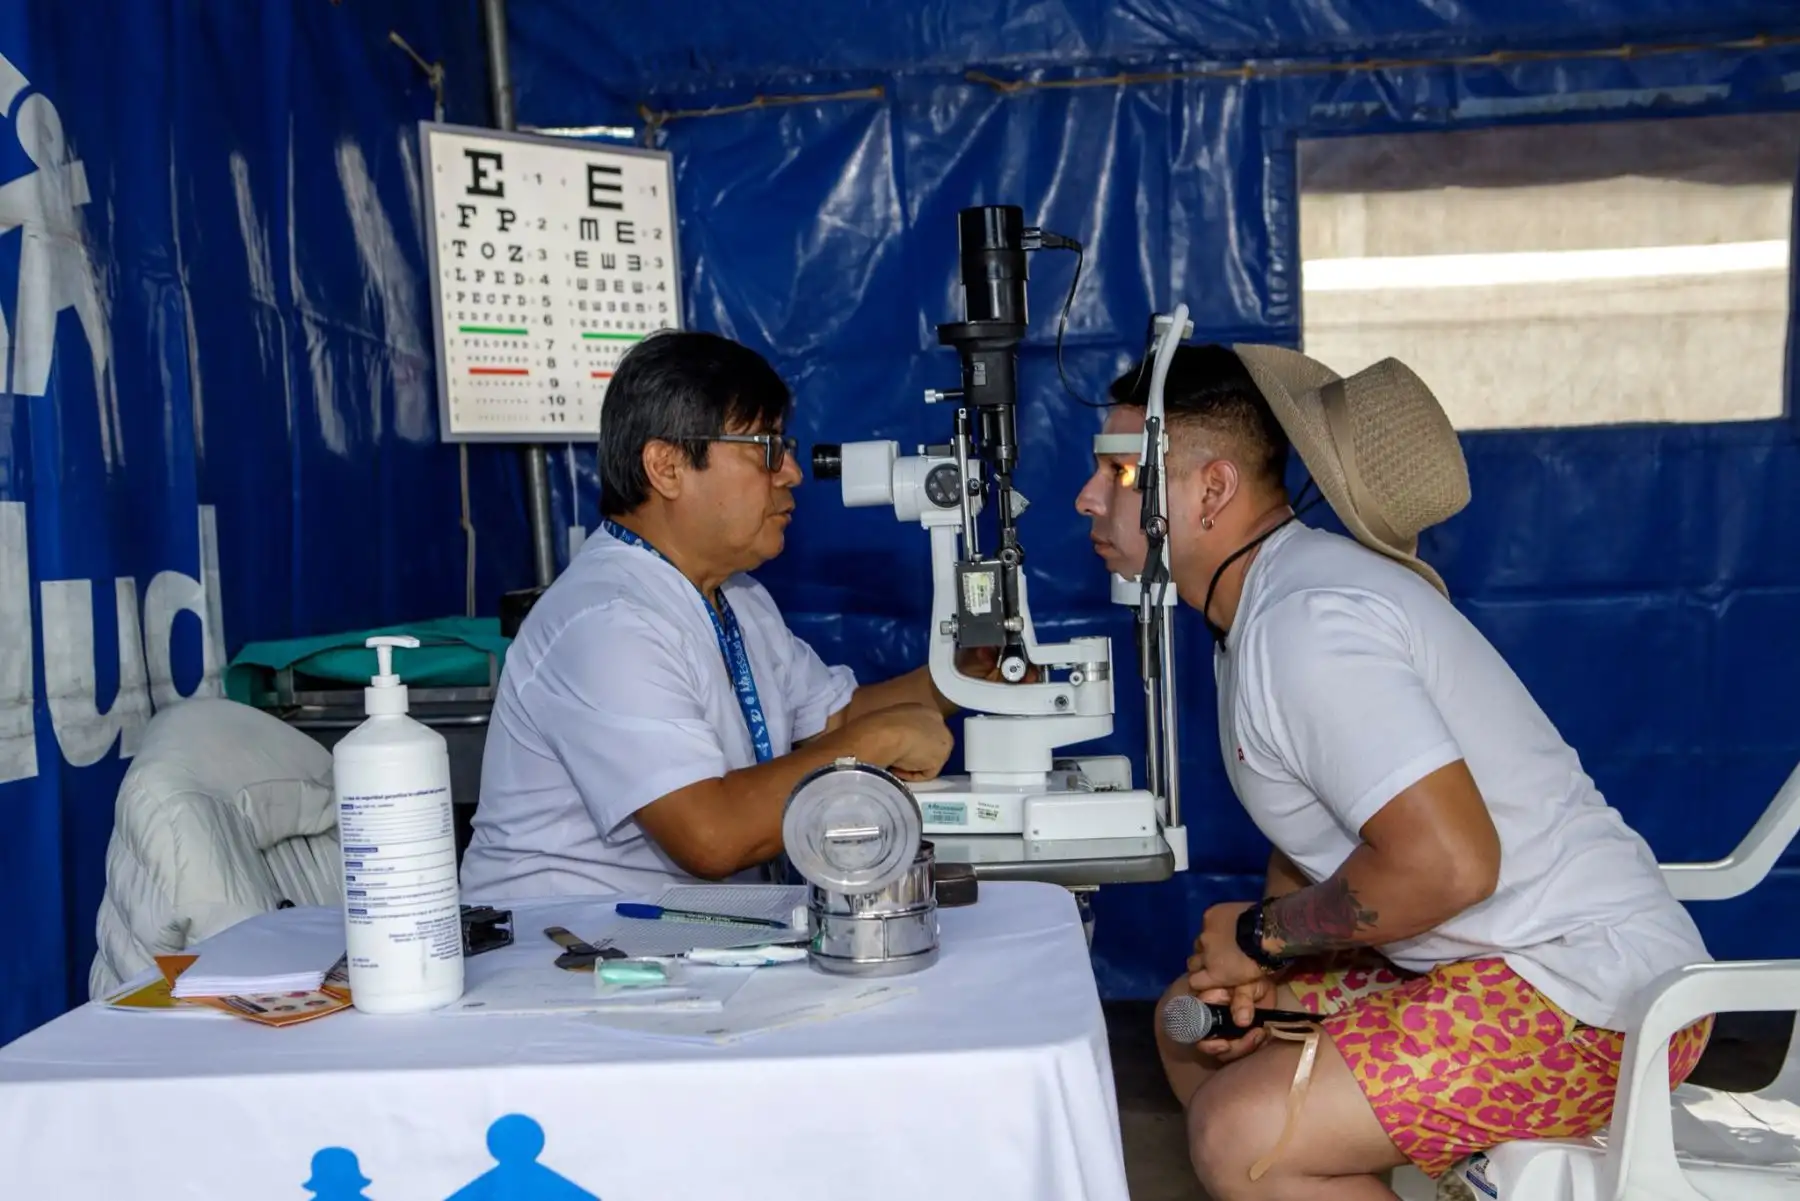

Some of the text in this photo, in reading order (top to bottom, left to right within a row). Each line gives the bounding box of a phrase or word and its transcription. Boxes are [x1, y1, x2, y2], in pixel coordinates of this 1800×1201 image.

[464, 148, 542, 198] E 1
[587, 163, 657, 210] E 1
[457, 204, 547, 232] F P 2
[616, 221, 635, 244] E
[452, 240, 467, 258] T
[481, 242, 495, 260] O
[508, 244, 523, 262] Z
[455, 267, 467, 282] L
[475, 269, 486, 283] P
[514, 272, 525, 286] D
[540, 274, 549, 285] 4
[656, 281, 666, 292] 4
[541, 295, 552, 308] 5
[545, 338, 554, 350] 7
[550, 378, 559, 389] 9
[548, 395, 566, 406] 10
[548, 412, 566, 424] 11
